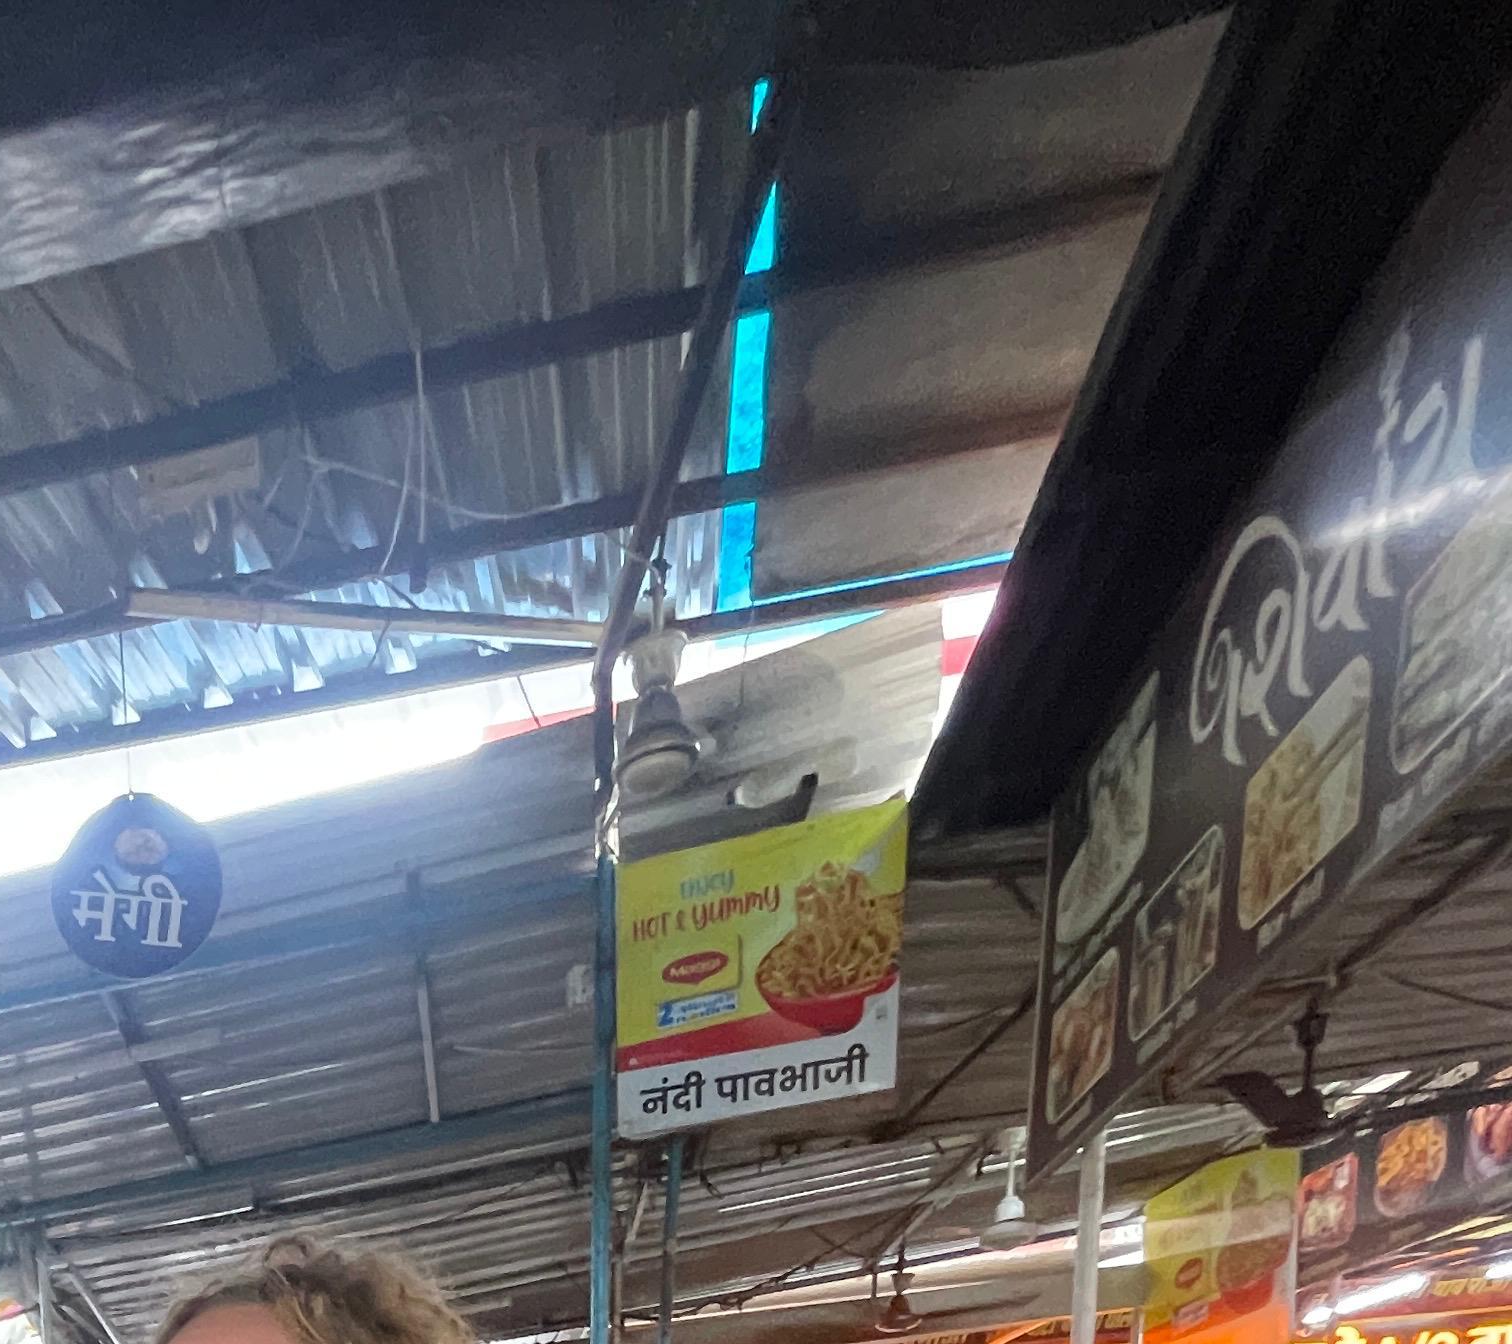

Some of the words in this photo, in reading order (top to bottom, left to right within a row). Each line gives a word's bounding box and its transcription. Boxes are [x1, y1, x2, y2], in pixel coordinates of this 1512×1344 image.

[632, 911, 671, 942] HOT
[640, 1069, 706, 1115] नंदी
[714, 1042, 870, 1103] पावभाजी
